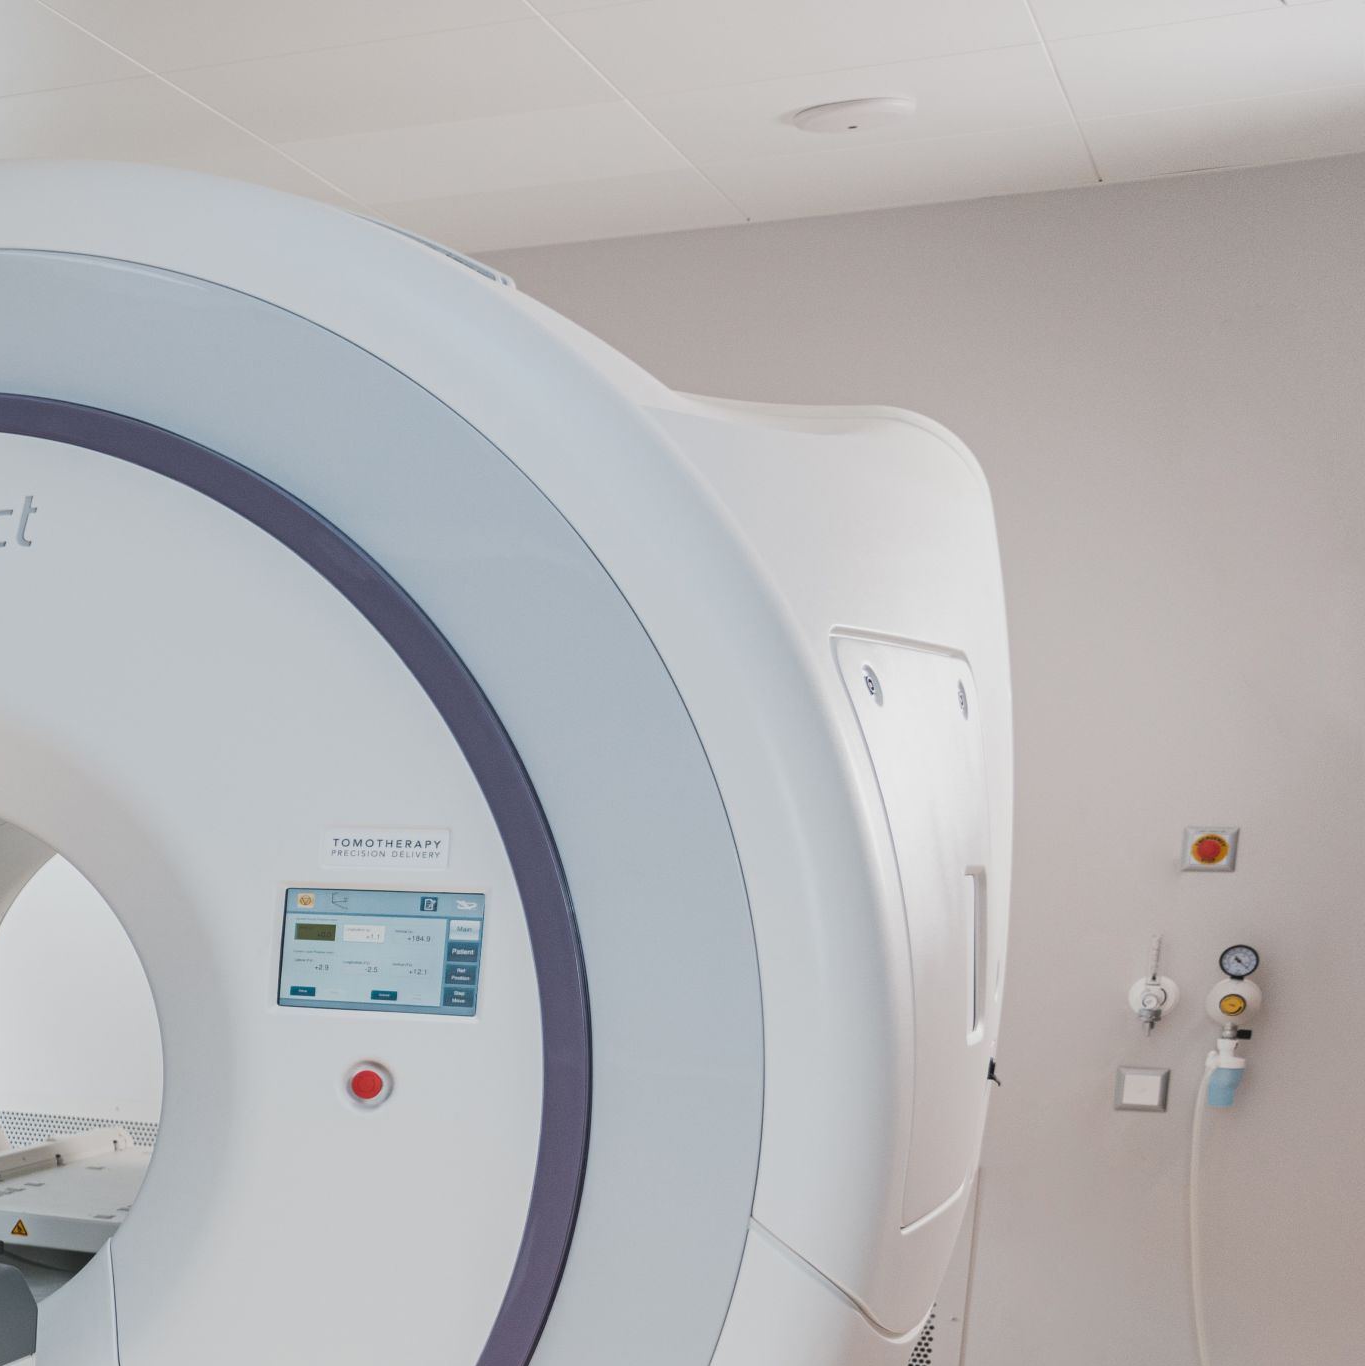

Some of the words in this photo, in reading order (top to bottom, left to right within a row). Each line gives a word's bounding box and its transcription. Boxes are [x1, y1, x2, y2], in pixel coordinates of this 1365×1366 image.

[332, 838, 442, 849] TOMOTHERAPY
[331, 849, 386, 858] PRECISION
[391, 850, 441, 859] DELIVERY
[451, 948, 474, 956] Patient
